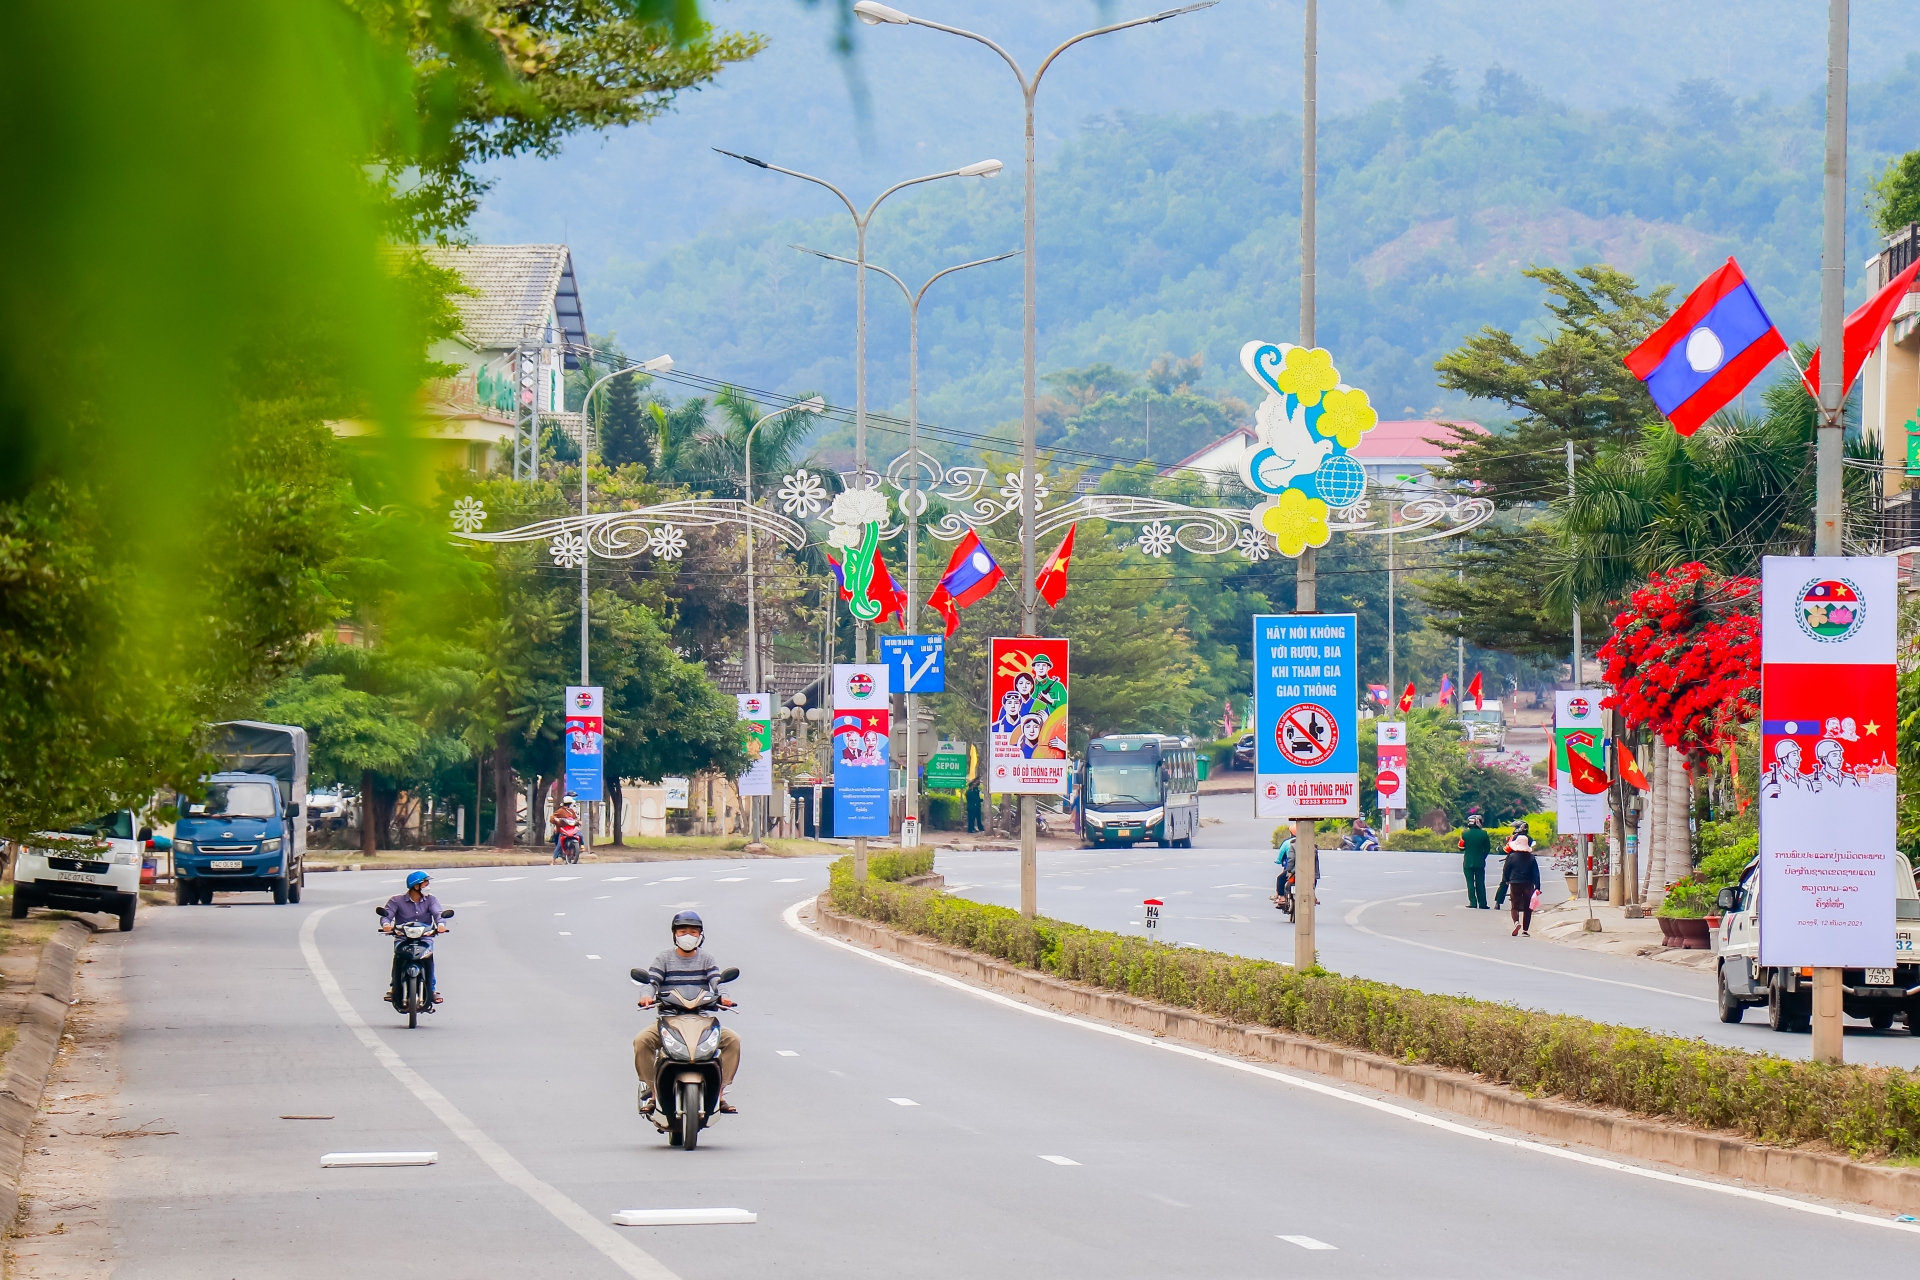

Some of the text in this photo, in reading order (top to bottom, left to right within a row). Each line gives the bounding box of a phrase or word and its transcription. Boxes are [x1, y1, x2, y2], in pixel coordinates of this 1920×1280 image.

[1266, 624, 1345, 639] HÃY NÓI KHÔNG
[1271, 644, 1341, 661] VỚI RƯỢU, BIA
[1271, 665, 1341, 678] KHI THAM GIA
[1276, 682, 1336, 697] GIAO THÔNG
[936, 762, 960, 770] SEPON
[1030, 765, 1048, 777] THÔNG
[1049, 766, 1063, 777] PHÁT
[1309, 781, 1333, 796] THÔNG
[1334, 781, 1353, 796] PHÁT
[1146, 906, 1159, 917] H4
[1146, 919, 1156, 929] 81
[1868, 975, 1891, 983] 7532
